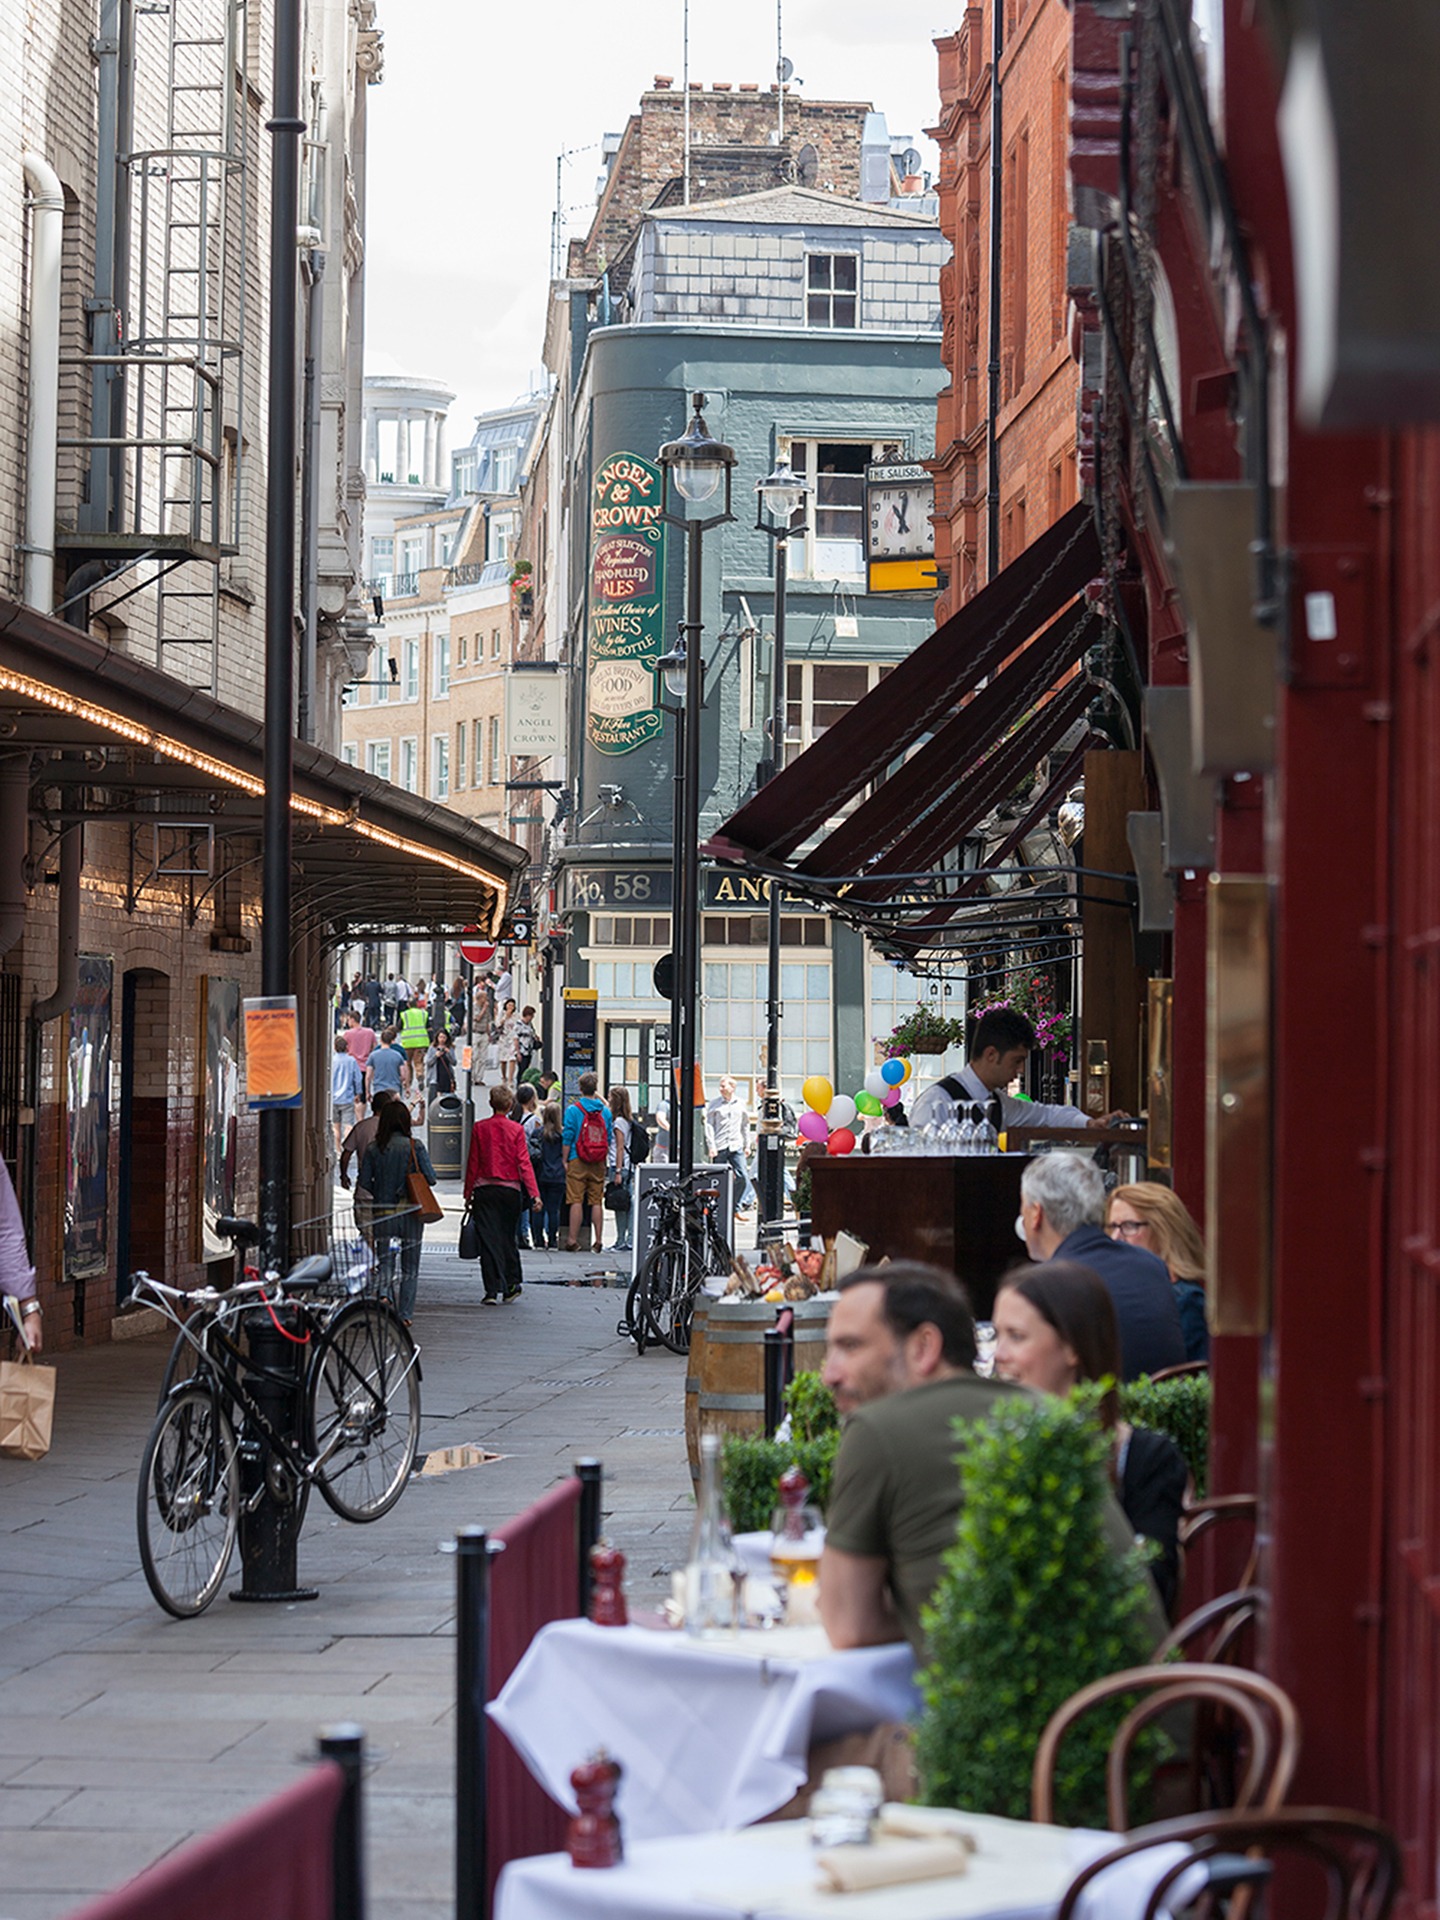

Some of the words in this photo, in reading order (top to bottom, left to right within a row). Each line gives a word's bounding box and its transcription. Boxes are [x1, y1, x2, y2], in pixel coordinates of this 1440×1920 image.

[596, 460, 654, 499] ANGEL
[870, 469, 884, 480] THE
[887, 467, 929, 478] SALISBU
[610, 483, 631, 504] &
[872, 502, 881, 512] 10
[593, 505, 662, 528] CROWN
[872, 520, 879, 529] 9
[615, 539, 653, 557] SELECTION
[872, 537, 878, 546] 8
[602, 580, 635, 597] ALES
[647, 602, 660, 618] of
[595, 616, 643, 638] WINES
[605, 634, 614, 649] by
[617, 633, 656, 657] BOTTLE
[612, 665, 646, 685] BRITISH
[600, 677, 633, 693] FOOD
[517, 718, 553, 727] ANGEL
[513, 733, 556, 743] CROWN
[592, 725, 646, 744] RESTAURANT
[613, 874, 651, 900] 58
[655, 1039, 666, 1052] TO
